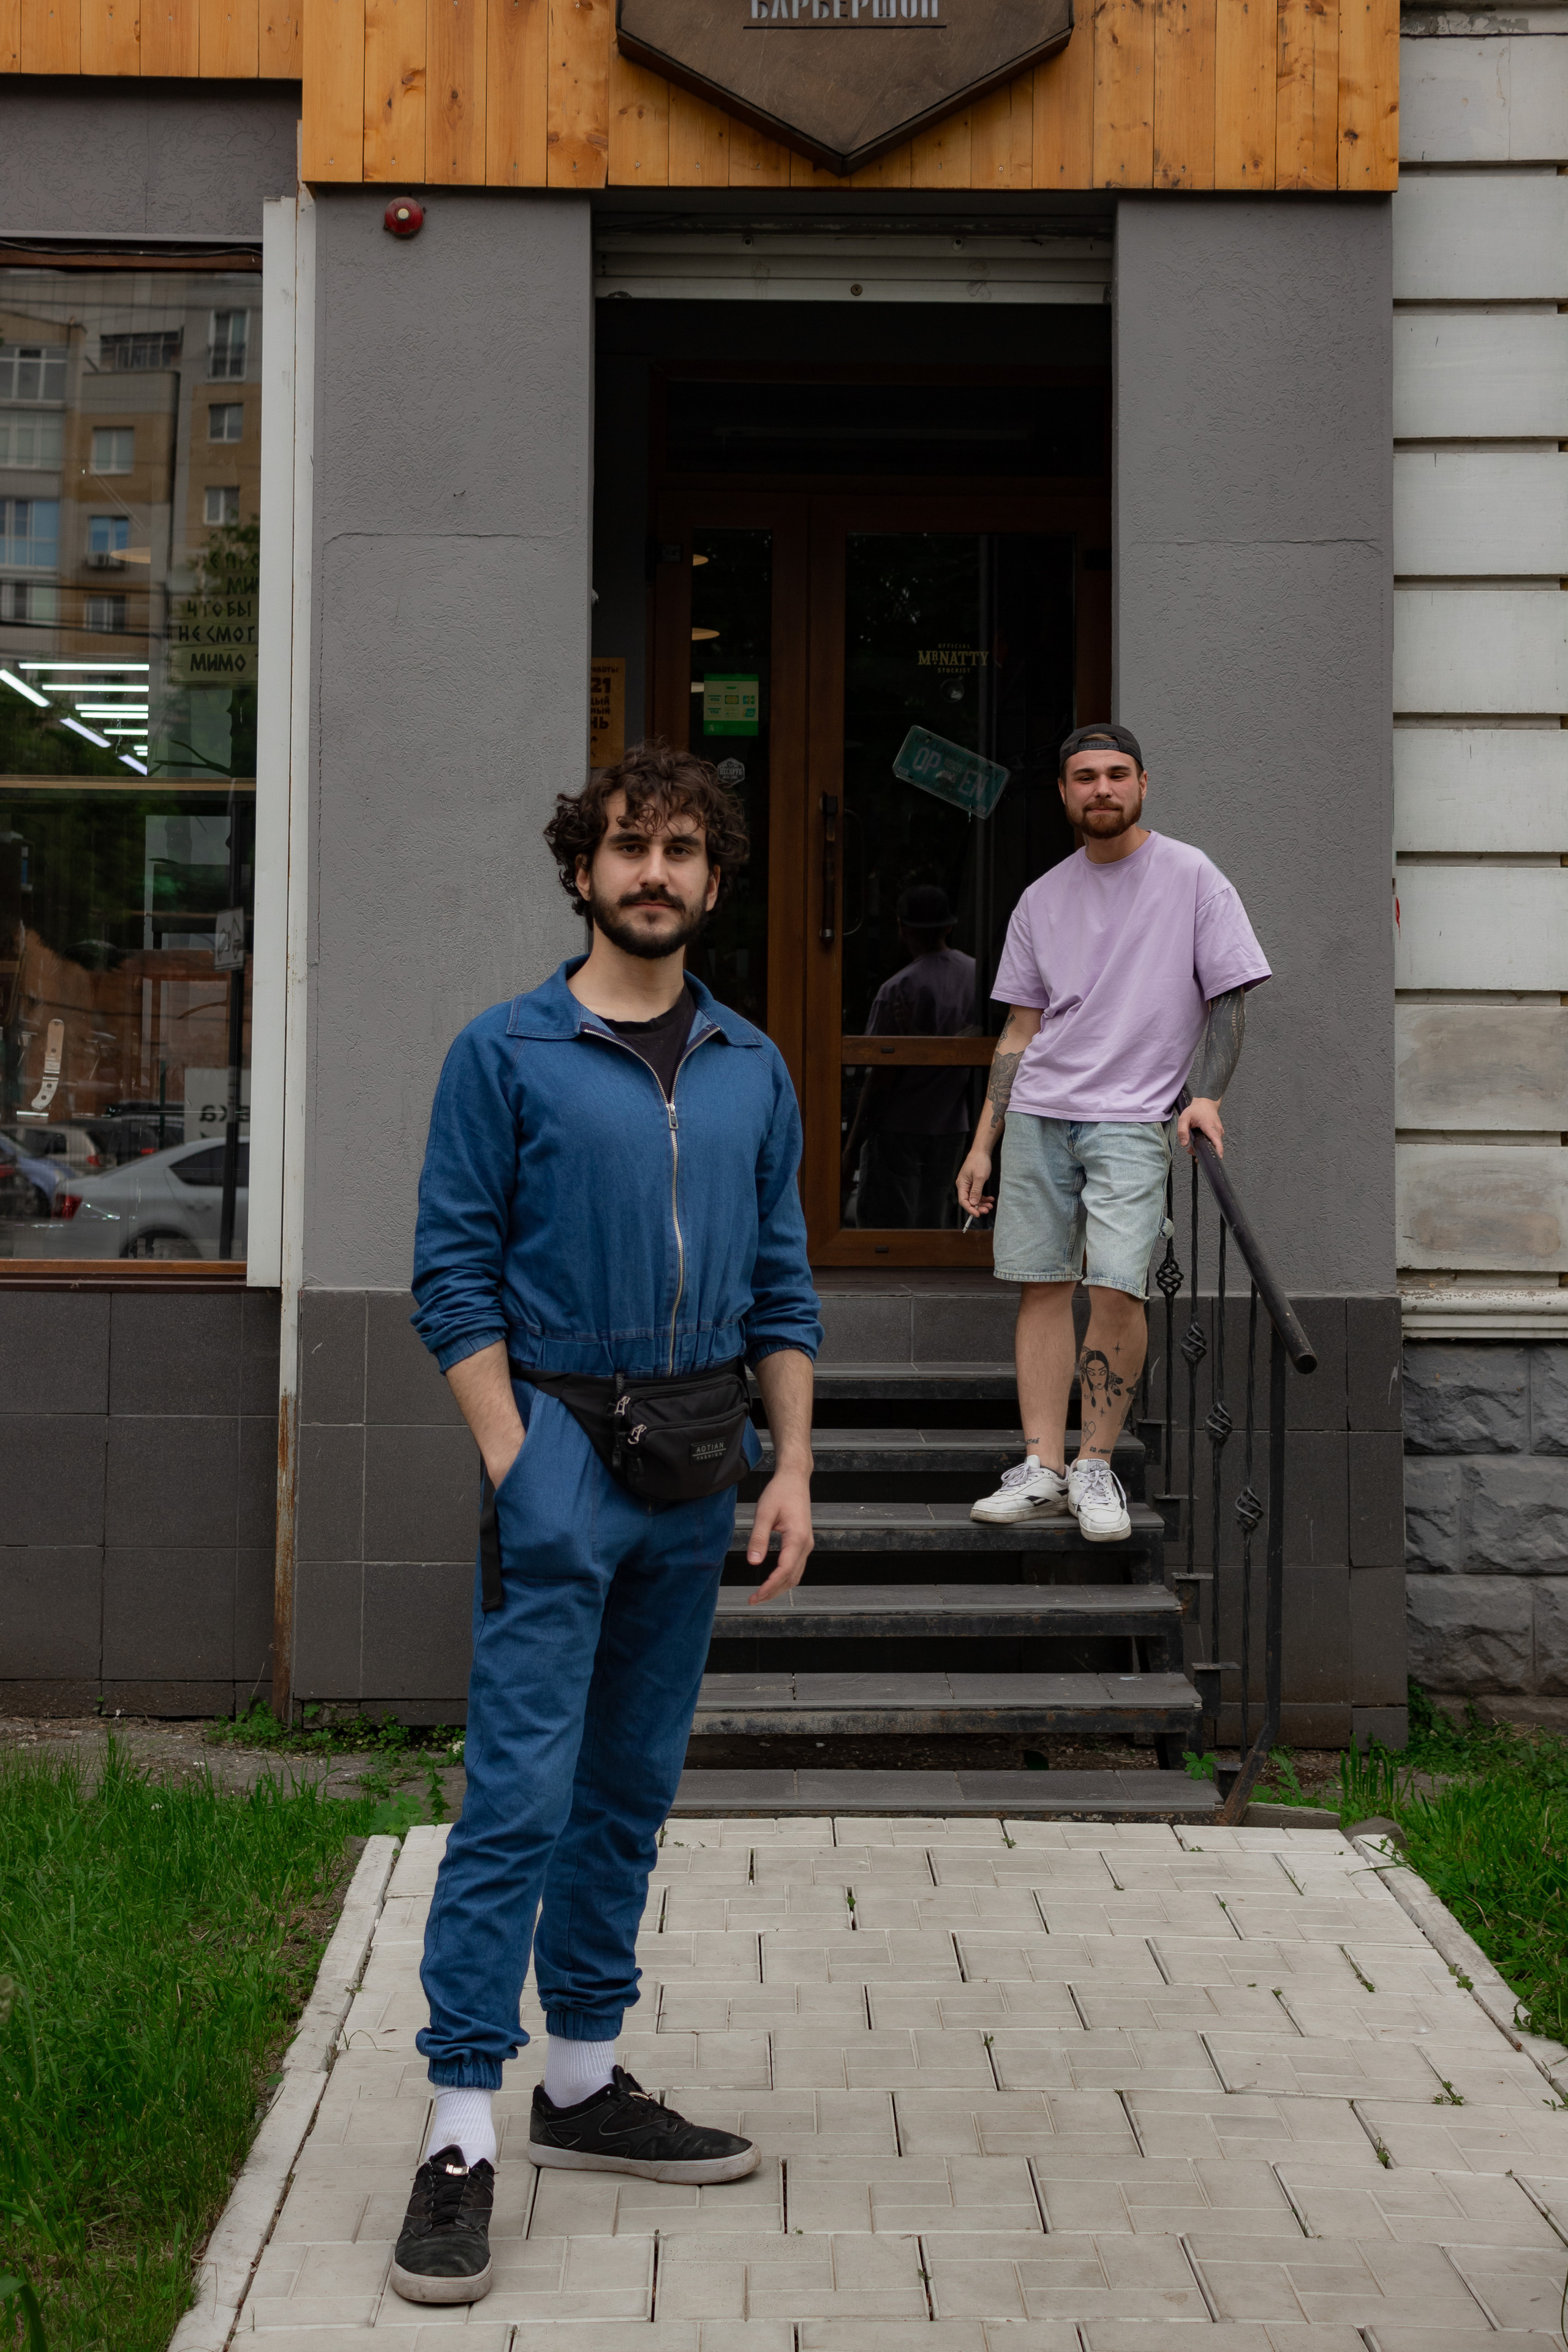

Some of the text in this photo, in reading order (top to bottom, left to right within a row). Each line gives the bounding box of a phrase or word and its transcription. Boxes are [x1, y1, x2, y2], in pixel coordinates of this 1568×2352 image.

[751, 0, 938, 19] БАРБЕРШОП
[187, 600, 251, 617] ЧТОБЫ
[190, 653, 246, 672] МИМО
[696, 1442, 725, 1453] AOTIAN
[696, 1452, 723, 1460] FASHION
